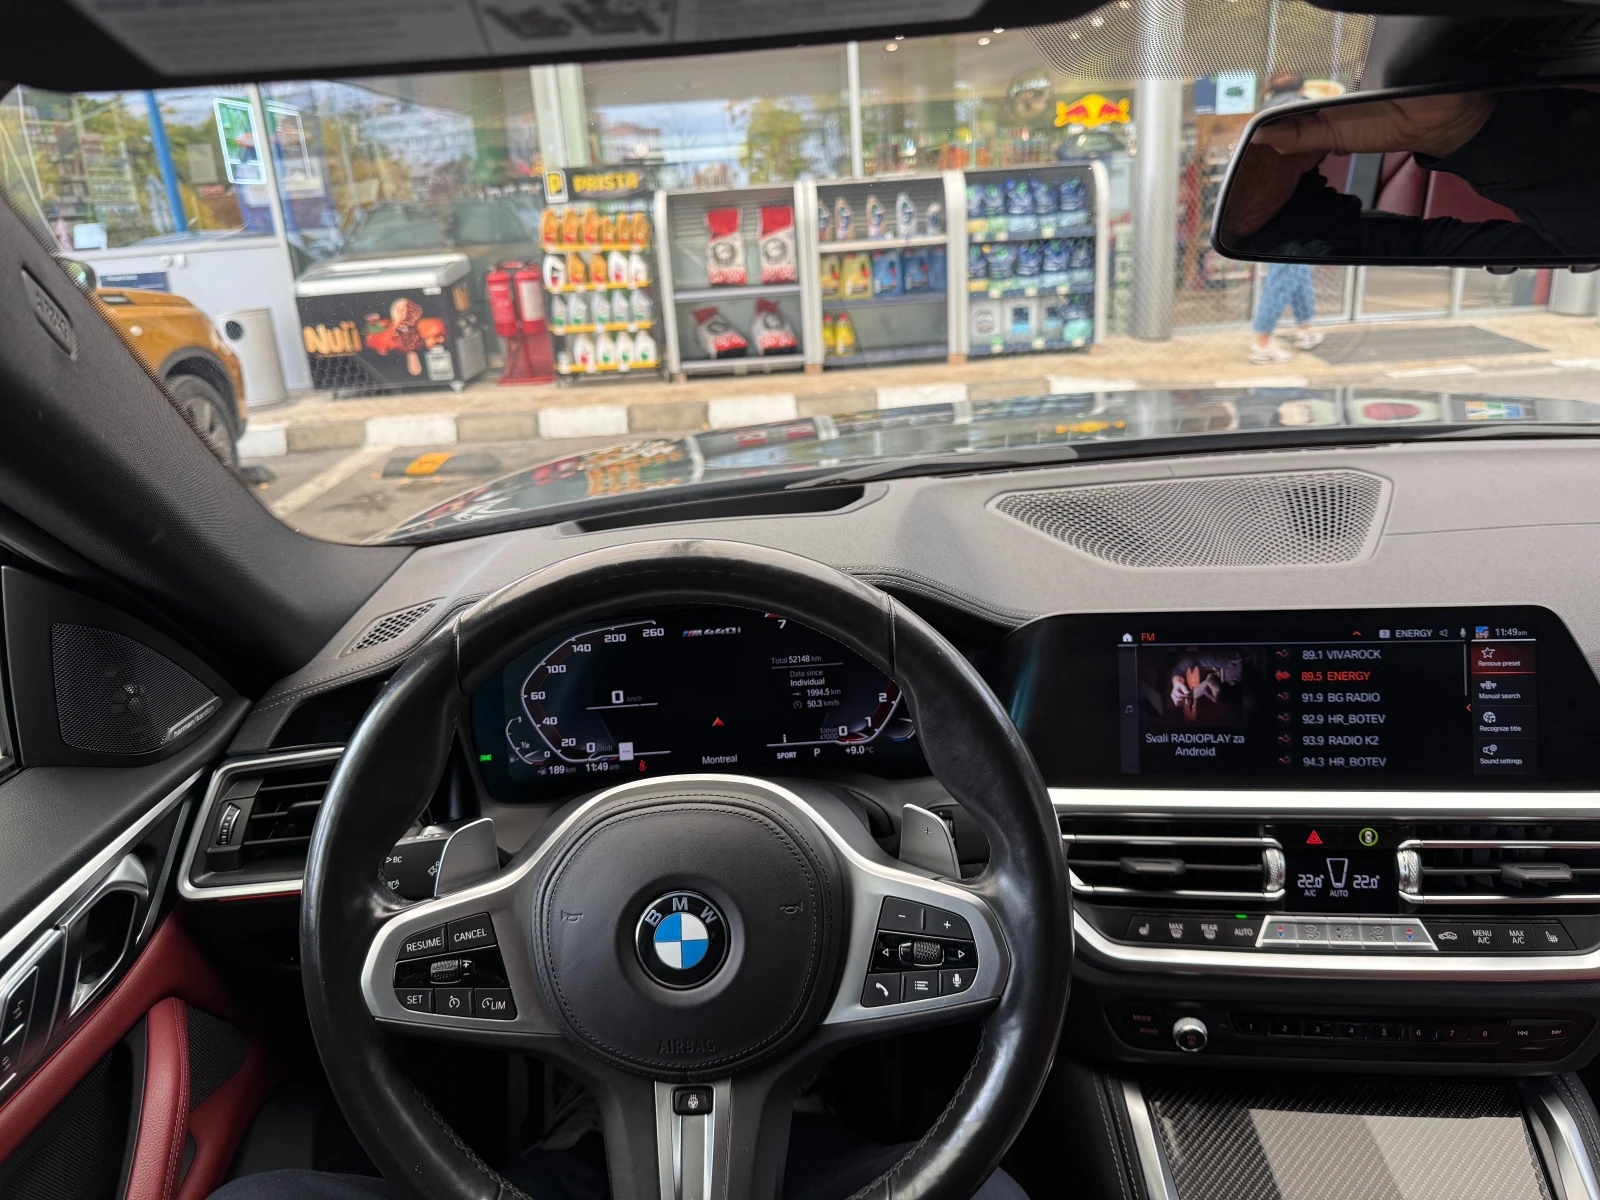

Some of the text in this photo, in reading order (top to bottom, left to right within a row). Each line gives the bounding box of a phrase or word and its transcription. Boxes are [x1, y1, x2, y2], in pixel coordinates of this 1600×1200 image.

[778, 619, 787, 629] 7
[643, 628, 664, 637] 260
[1141, 633, 1155, 641] FM
[1395, 629, 1433, 638] ENERGY
[604, 633, 627, 643] 200
[571, 643, 592, 653] 140
[1302, 650, 1382, 659] 89.1 VIVAROCK
[771, 657, 788, 665] Total
[788, 655, 811, 664] 52148
[546, 664, 567, 674] 100
[790, 669, 824, 678] Data since
[1301, 671, 1371, 681] 89.5 ENERGY
[790, 678, 825, 687] Individual
[530, 691, 546, 700] 60
[611, 690, 624, 704] 0
[807, 688, 830, 697] 1994.5
[878, 692, 888, 702] 2
[1301, 693, 1381, 702] 91.9 BG RADIO
[807, 700, 823, 708] 50.3
[542, 716, 558, 726] 40
[864, 717, 872, 727] 1
[1302, 714, 1386, 725] 92.9 HR_BOTEV
[838, 725, 848, 736] 0
[561, 738, 576, 747] 20
[1145, 733, 1245, 743] Svali RADIOPLAY za
[1302, 735, 1379, 745] 93.9 RADIO K2
[586, 742, 596, 753] 0
[845, 745, 865, 755] +9.0
[1175, 747, 1216, 756] Android
[776, 748, 820, 760] SPORT P
[702, 754, 738, 765] Montreal
[1303, 757, 1387, 768] 94.3 HR_BOTEV
[548, 765, 577, 775] 189 km
[585, 762, 609, 772] 11:49
[1329, 889, 1349, 898] AUTO
[645, 896, 718, 928] BMW
[1168, 922, 1184, 931] MAX
[1200, 923, 1218, 932] REAR
[454, 928, 487, 942] CANCEL
[1234, 928, 1253, 936] AUTO
[1472, 929, 1492, 937] MENU
[1509, 929, 1524, 937] MAX
[406, 936, 442, 952] RESUME
[1478, 936, 1490, 944] A/C
[1512, 936, 1525, 944] A/C
[407, 994, 423, 1005] SET
[491, 1001, 506, 1010] LIM
[658, 1039, 715, 1054] AIRBAG
